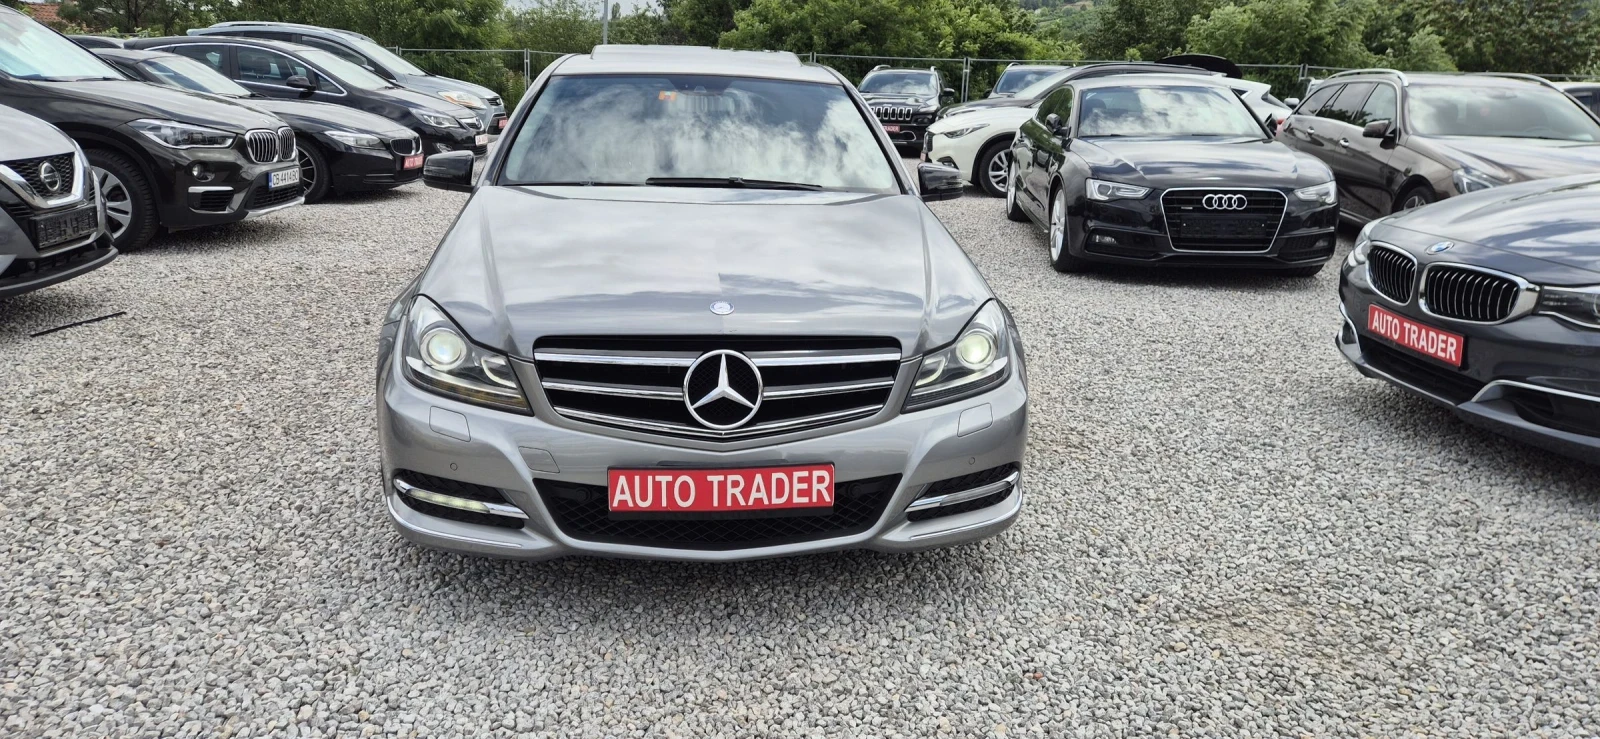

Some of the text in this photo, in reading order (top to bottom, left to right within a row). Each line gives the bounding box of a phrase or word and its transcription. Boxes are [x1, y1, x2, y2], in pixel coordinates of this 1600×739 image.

[1372, 310, 1457, 361] AUTO TRADER
[612, 470, 831, 508] AUTO TRADER
